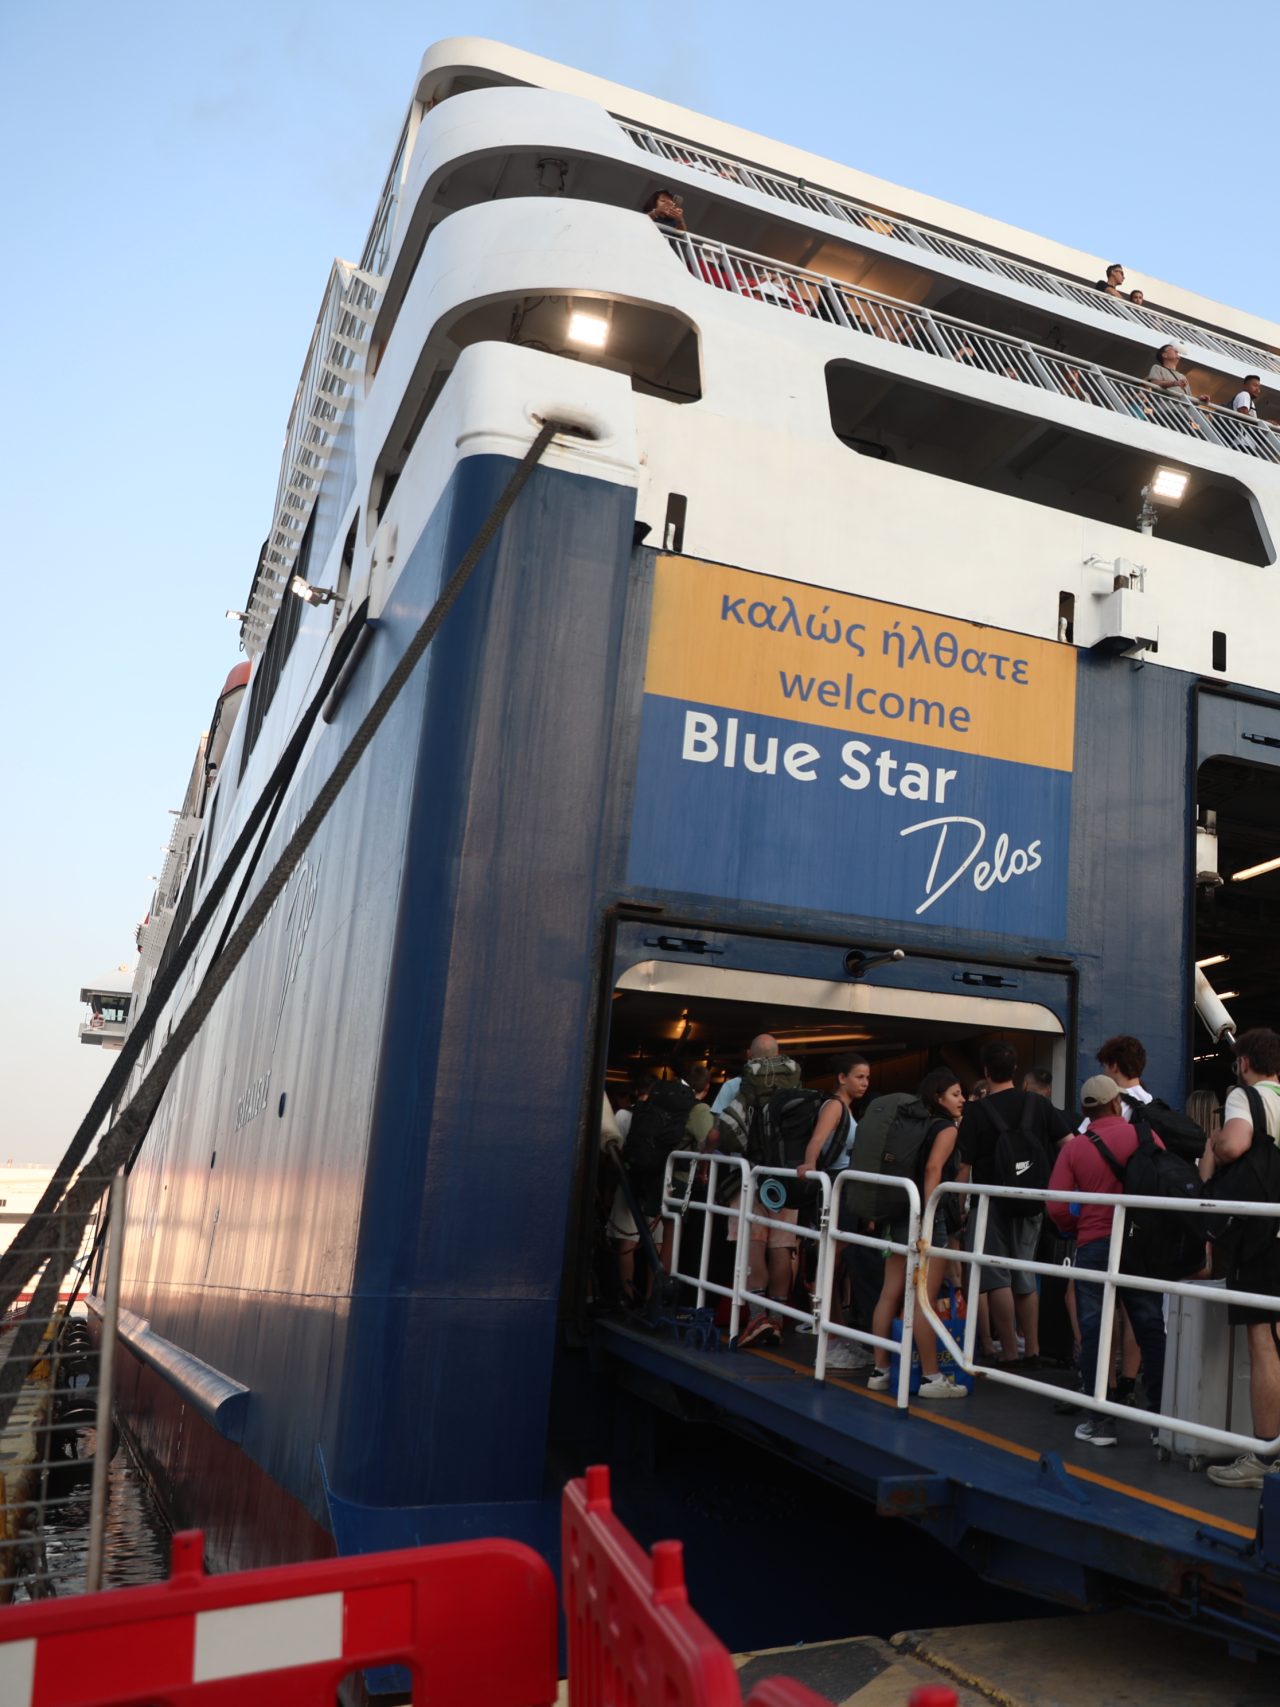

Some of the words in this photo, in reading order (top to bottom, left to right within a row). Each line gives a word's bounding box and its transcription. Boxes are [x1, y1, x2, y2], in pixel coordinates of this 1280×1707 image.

[720, 594, 866, 657] καλώς
[882, 620, 1029, 685] ήλθατε
[779, 669, 972, 733] welcome
[681, 710, 821, 782] Blue
[839, 740, 957, 804] Star
[900, 815, 1042, 915] Delos
